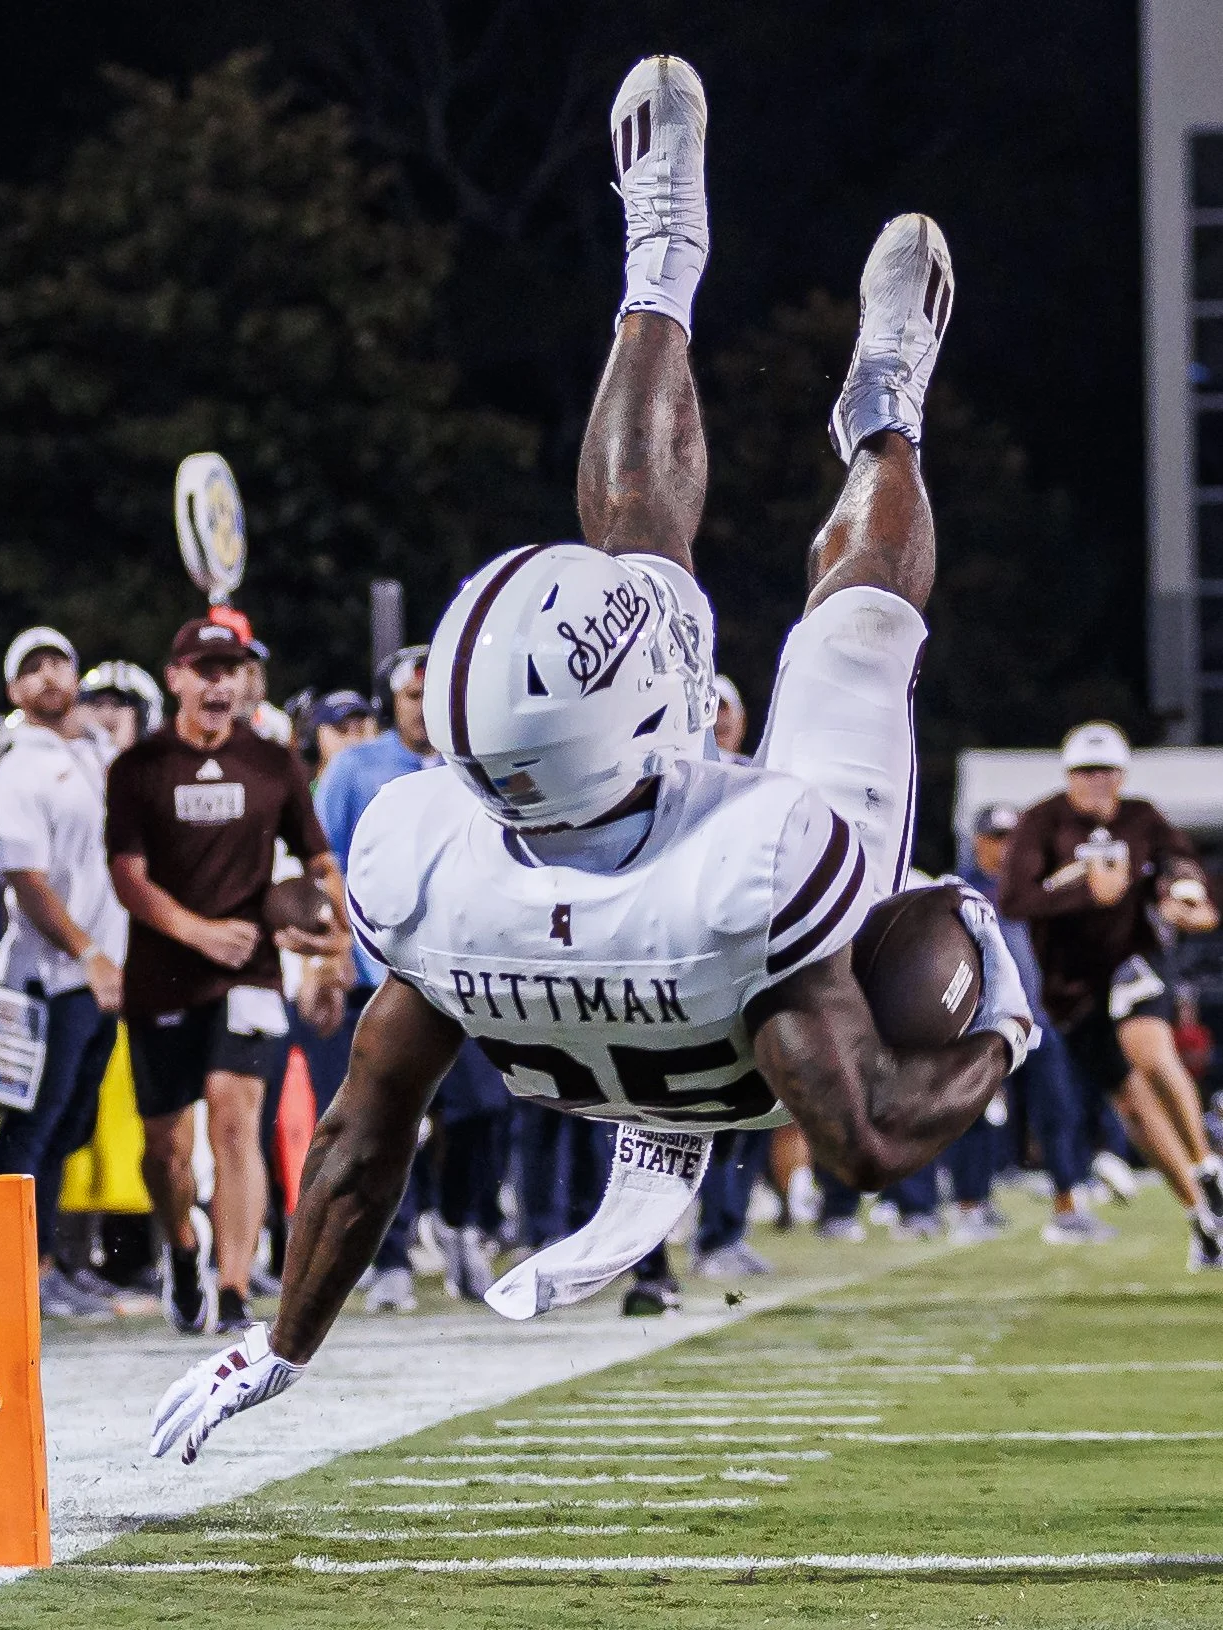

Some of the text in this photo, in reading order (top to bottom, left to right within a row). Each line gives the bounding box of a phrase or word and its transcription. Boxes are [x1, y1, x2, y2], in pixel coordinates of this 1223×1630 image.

[557, 580, 650, 699] State
[450, 969, 690, 1024] PITTMAN
[619, 1136, 701, 1180] STATE
